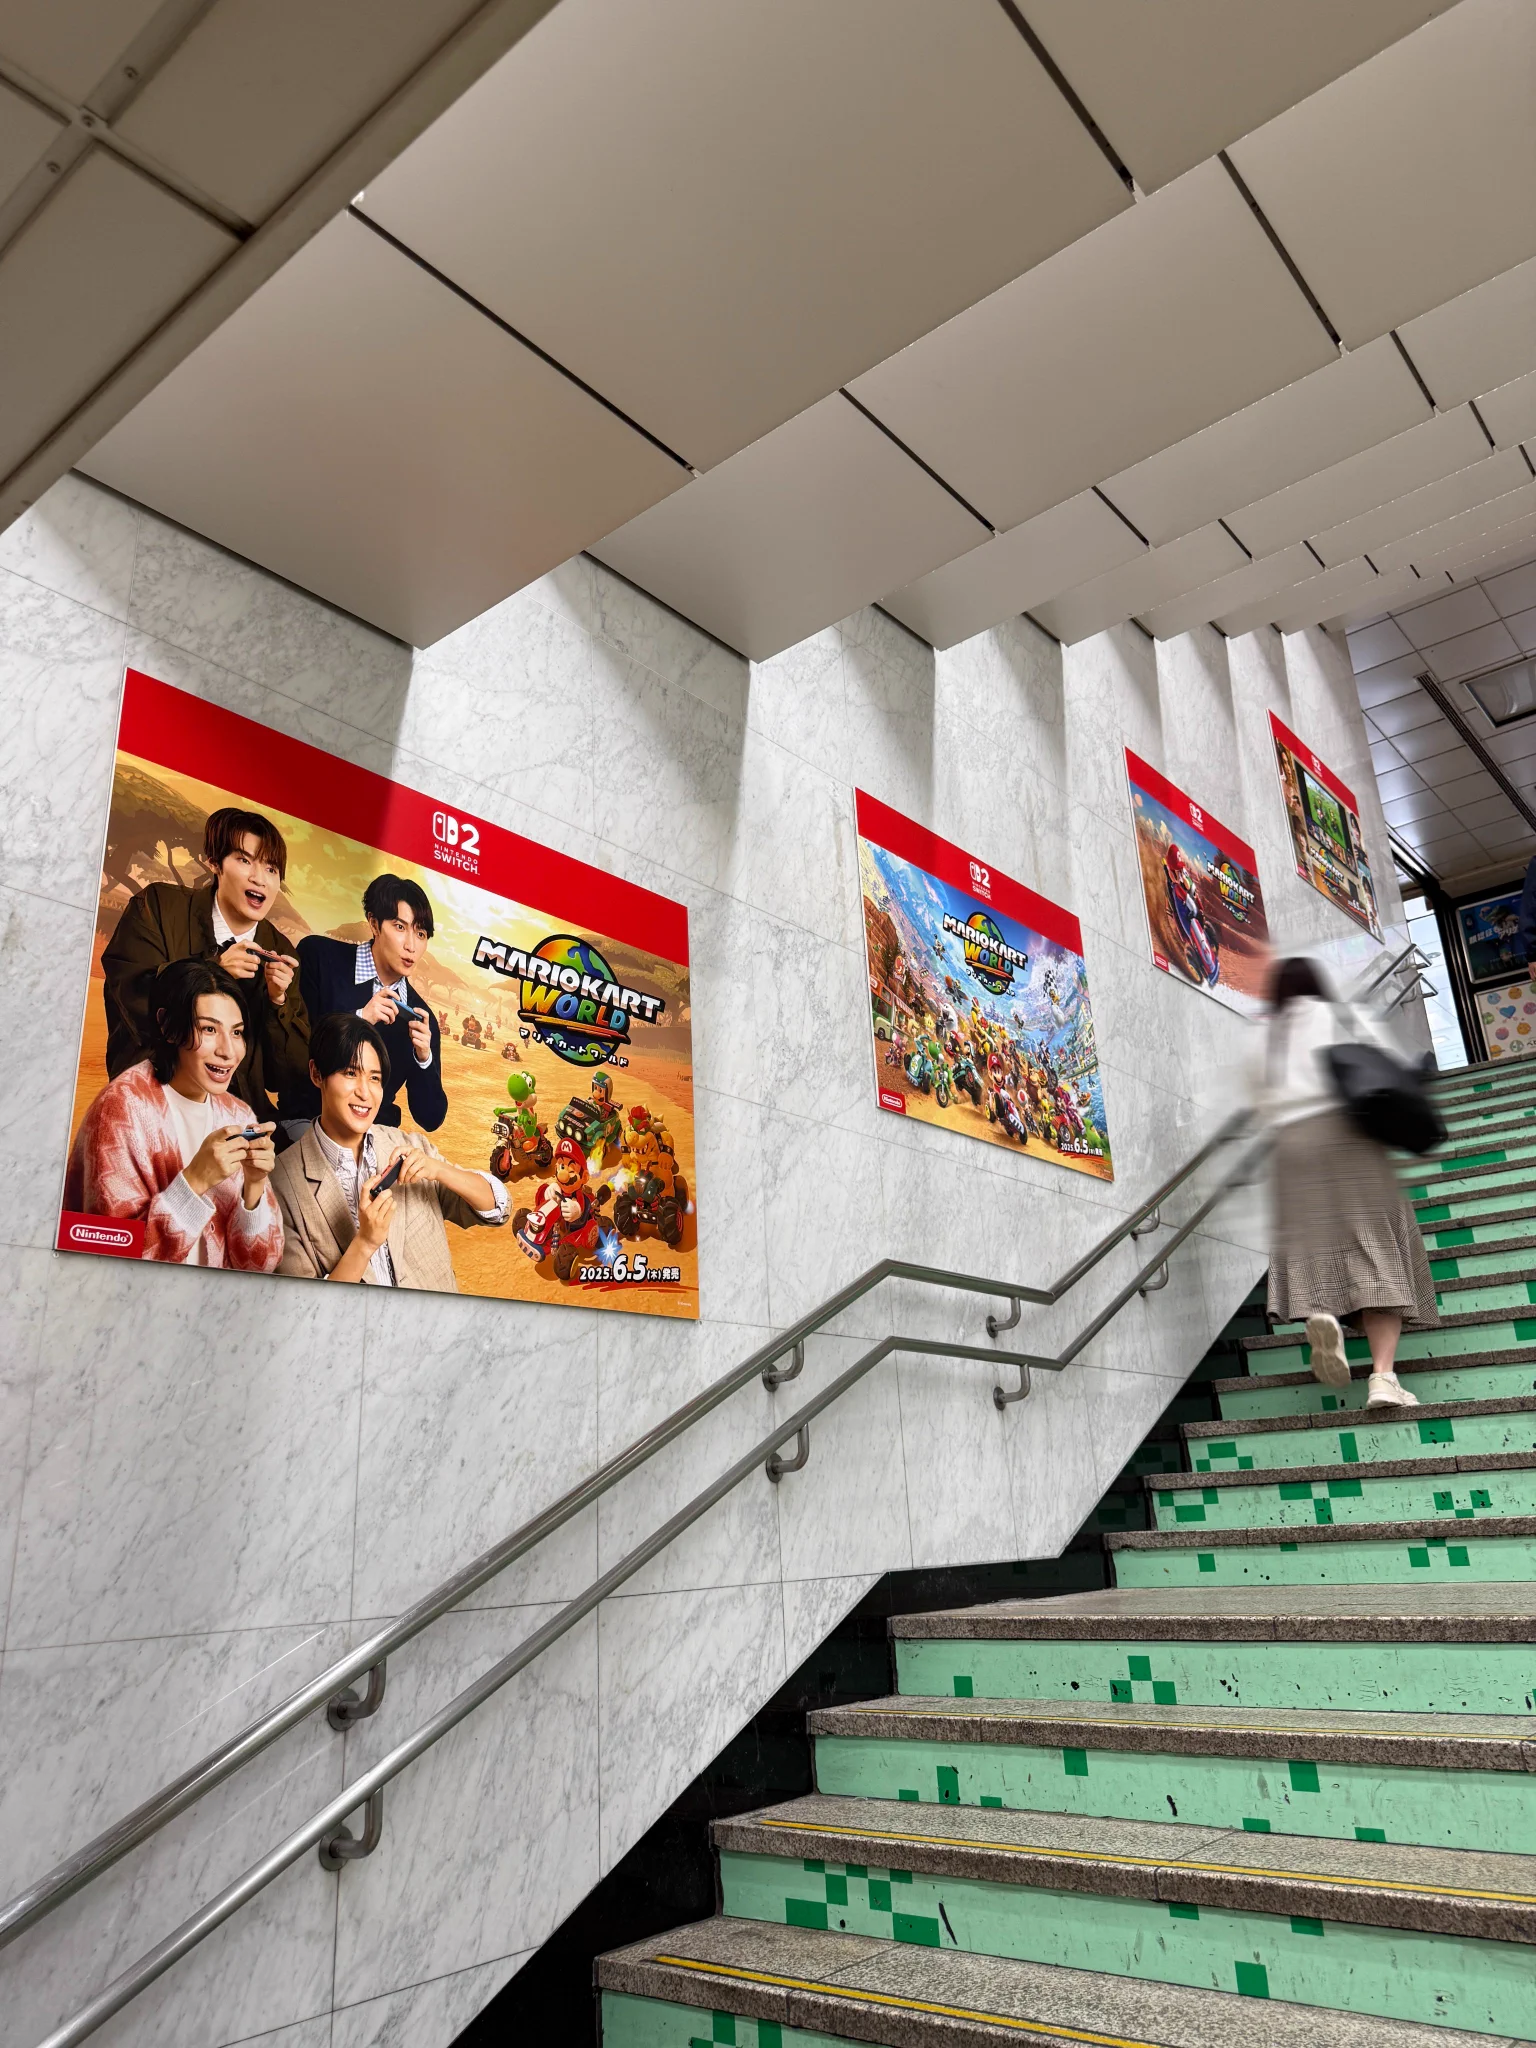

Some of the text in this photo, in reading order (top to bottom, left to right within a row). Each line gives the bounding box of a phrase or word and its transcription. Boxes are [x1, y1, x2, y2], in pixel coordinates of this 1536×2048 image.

[460, 823, 480, 856] 2
[433, 849, 478, 875] SWITCH
[434, 843, 478, 865] NINTENDO
[980, 867, 991, 889] 2
[1220, 880, 1248, 907] WORLD
[964, 939, 1014, 972] WORLD
[521, 980, 627, 1031] WORLD
[75, 1227, 128, 1243] Nintendo
